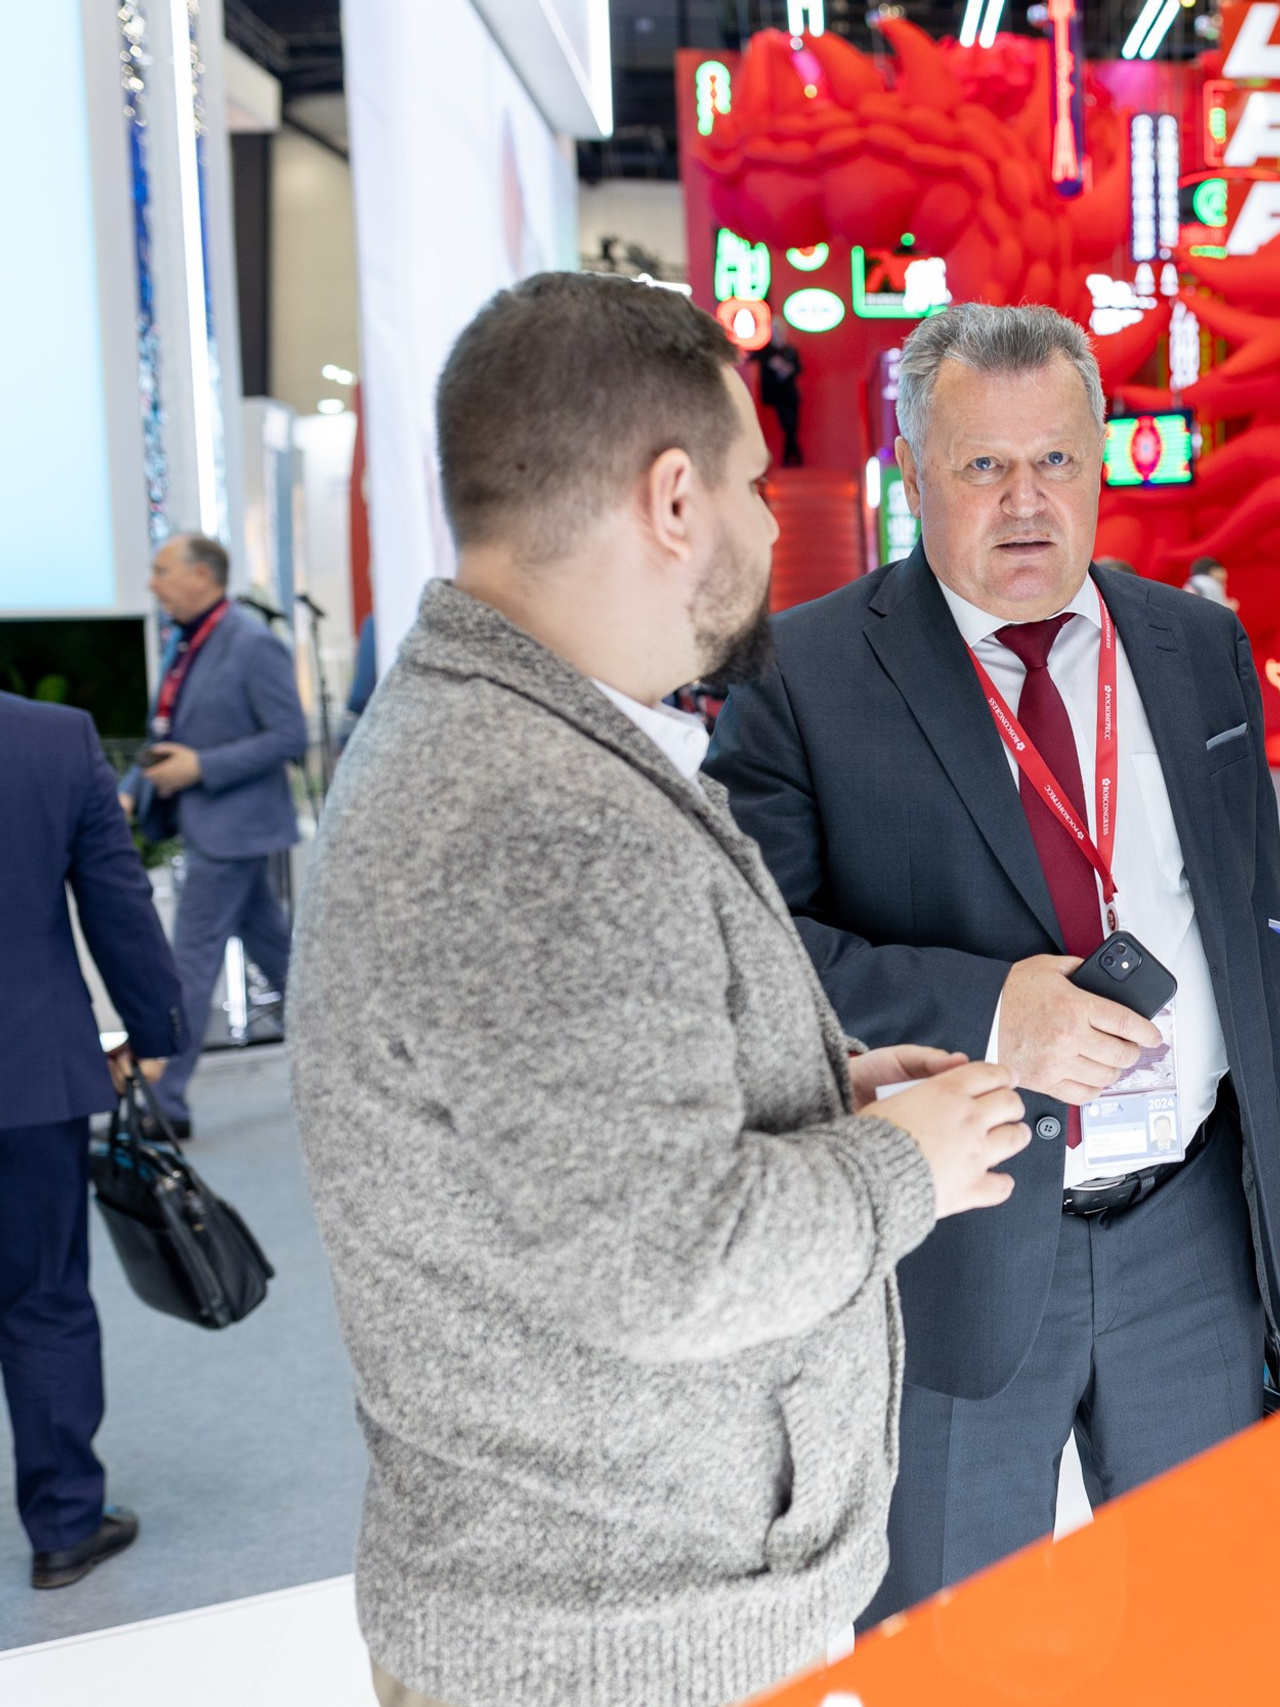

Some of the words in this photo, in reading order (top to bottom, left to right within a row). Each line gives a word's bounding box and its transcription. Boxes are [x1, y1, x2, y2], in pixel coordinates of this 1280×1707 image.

[988, 697, 1020, 744] ROSCONGRESS
[1044, 784, 1080, 833] РОСКОНГРЕСС
[1148, 1097, 1175, 1111] 2024
